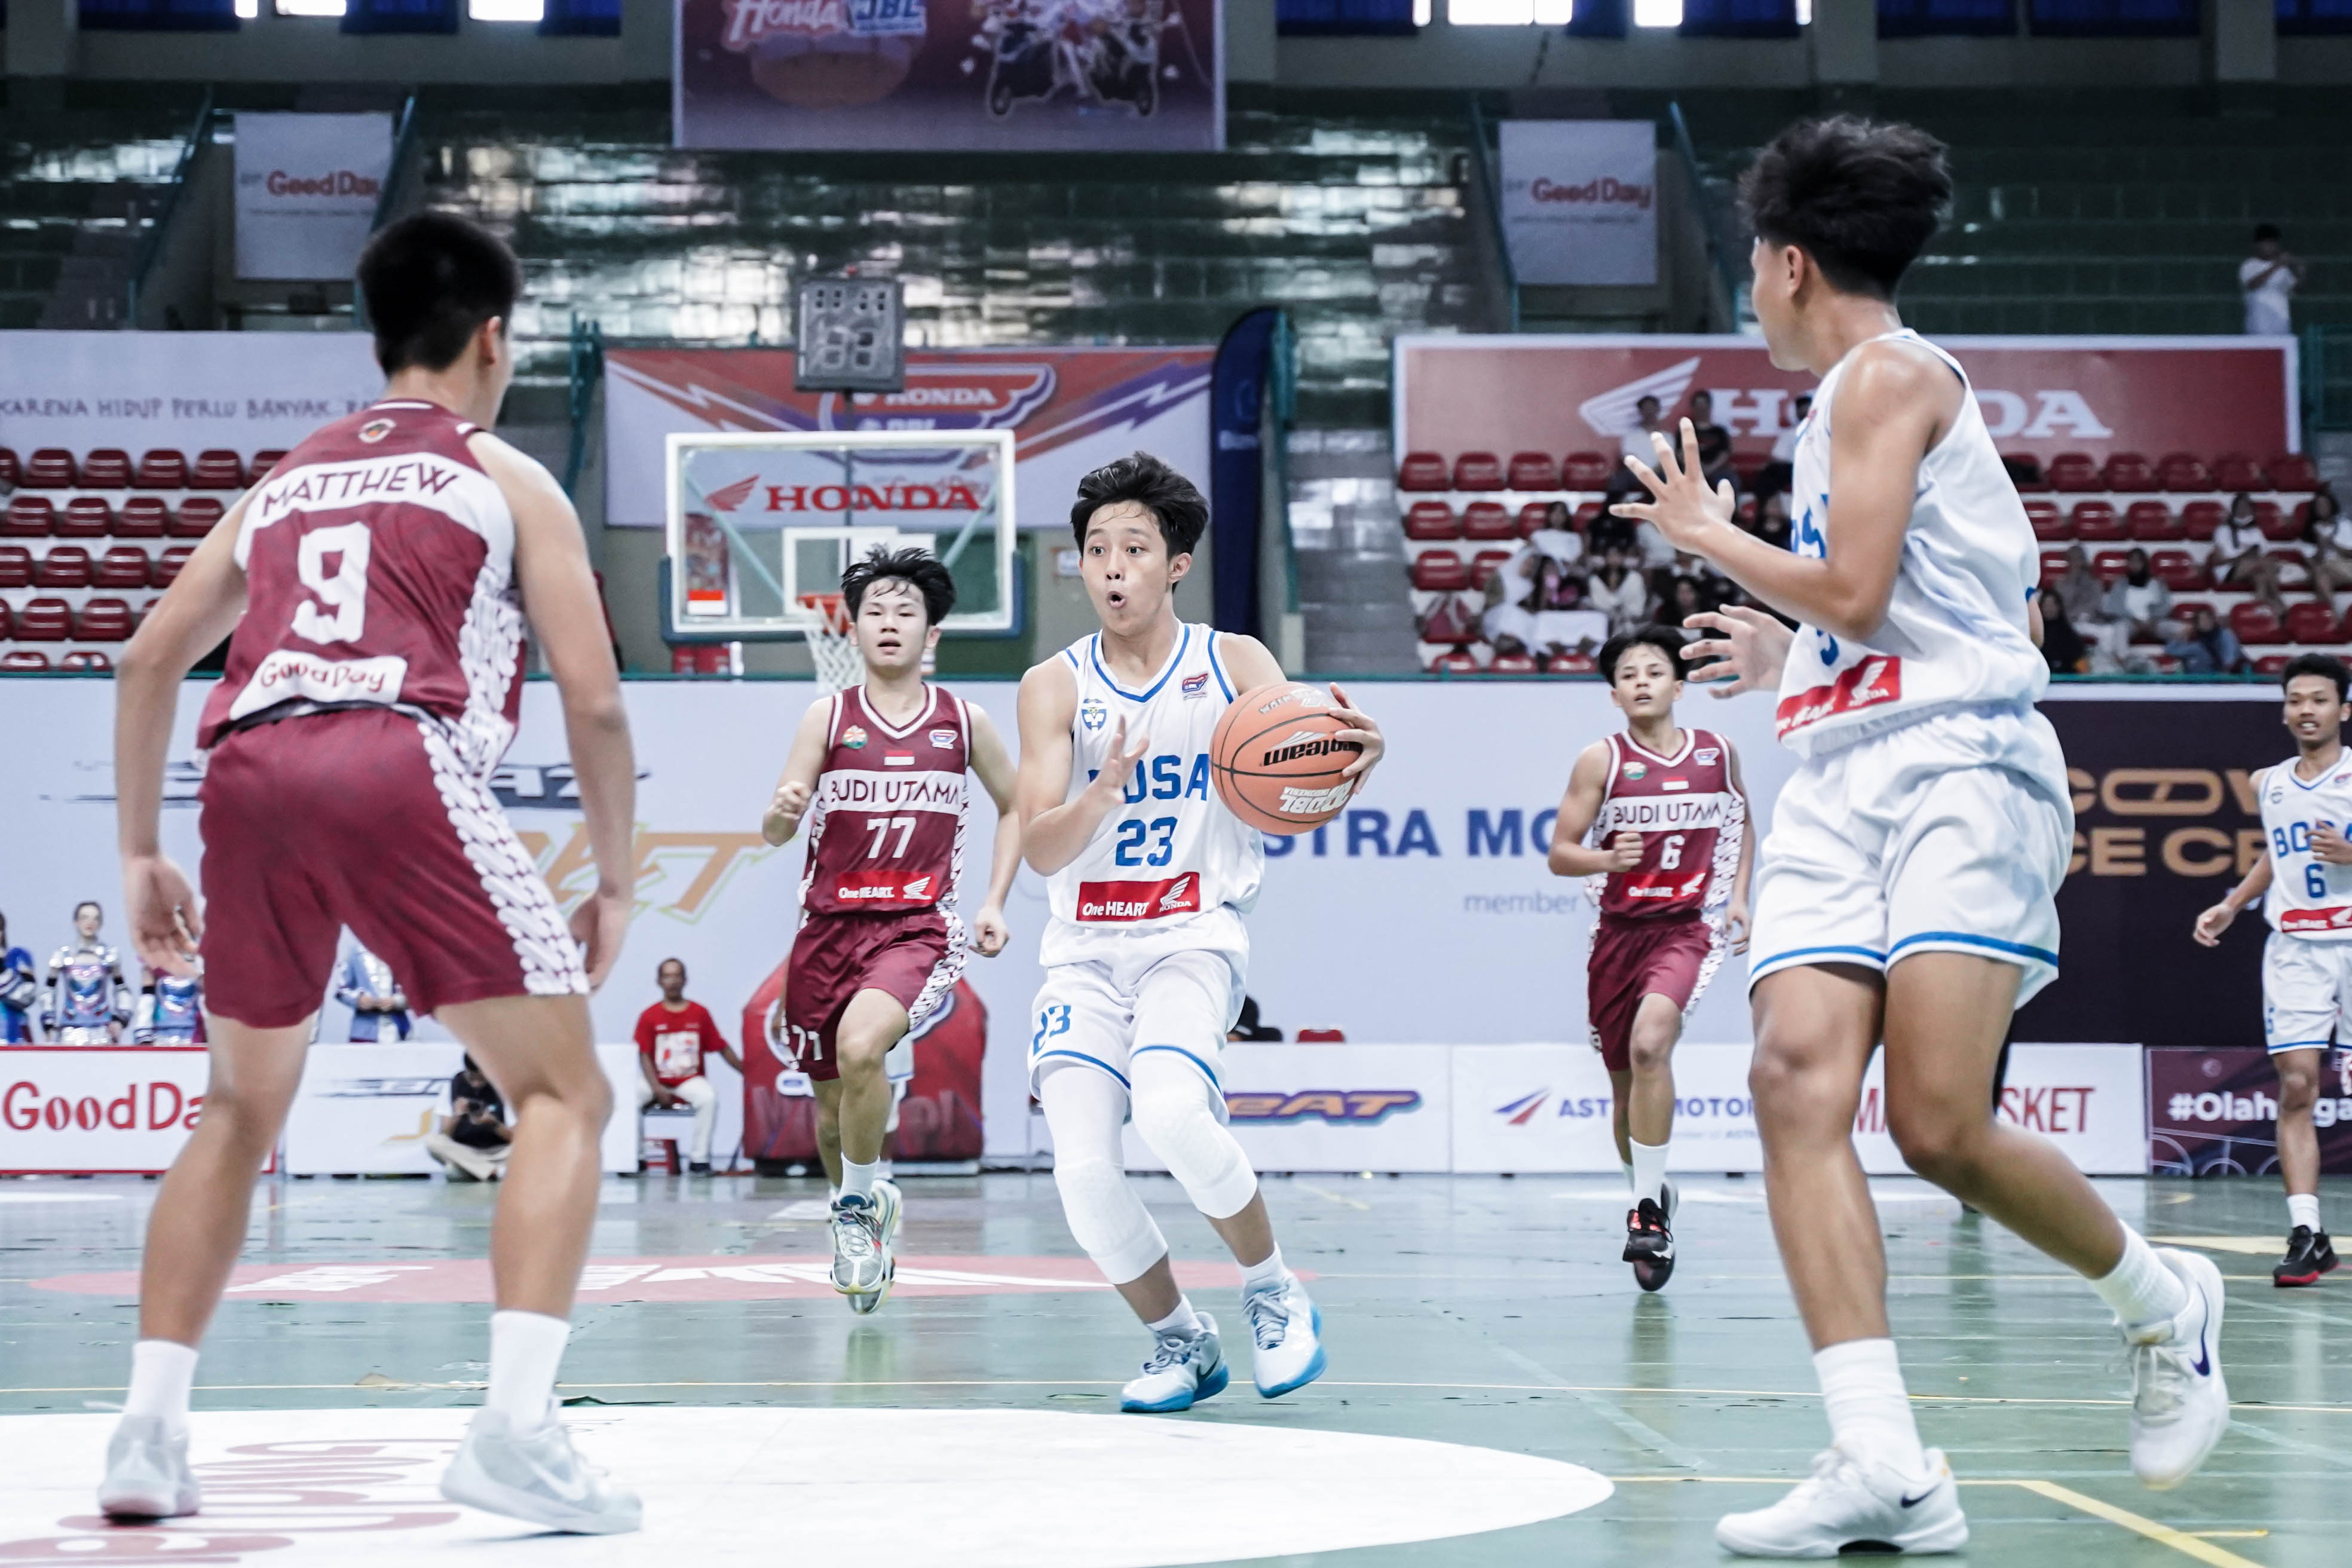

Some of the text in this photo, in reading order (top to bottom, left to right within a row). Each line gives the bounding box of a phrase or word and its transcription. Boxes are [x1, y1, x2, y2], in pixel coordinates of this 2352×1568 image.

[1711, 389, 2114, 439] HDA
[262, 463, 460, 517] MATTHEW
[765, 485, 981, 512] HONDA
[290, 521, 372, 645] 9
[1088, 754, 1209, 804] OSA
[1613, 804, 1659, 824] BUDI
[866, 817, 917, 859] 77
[1115, 816, 1178, 866] 23
[1661, 834, 1686, 871] 6
[2273, 818, 2352, 859] BO
[1463, 889, 1579, 914] member
[2305, 863, 2327, 899] 6
[1082, 900, 1192, 917] One HEART HONDA
[1033, 1004, 1071, 1056] 23
[3, 1081, 137, 1131] Good
[2167, 1091, 2352, 1128] #Olahga
